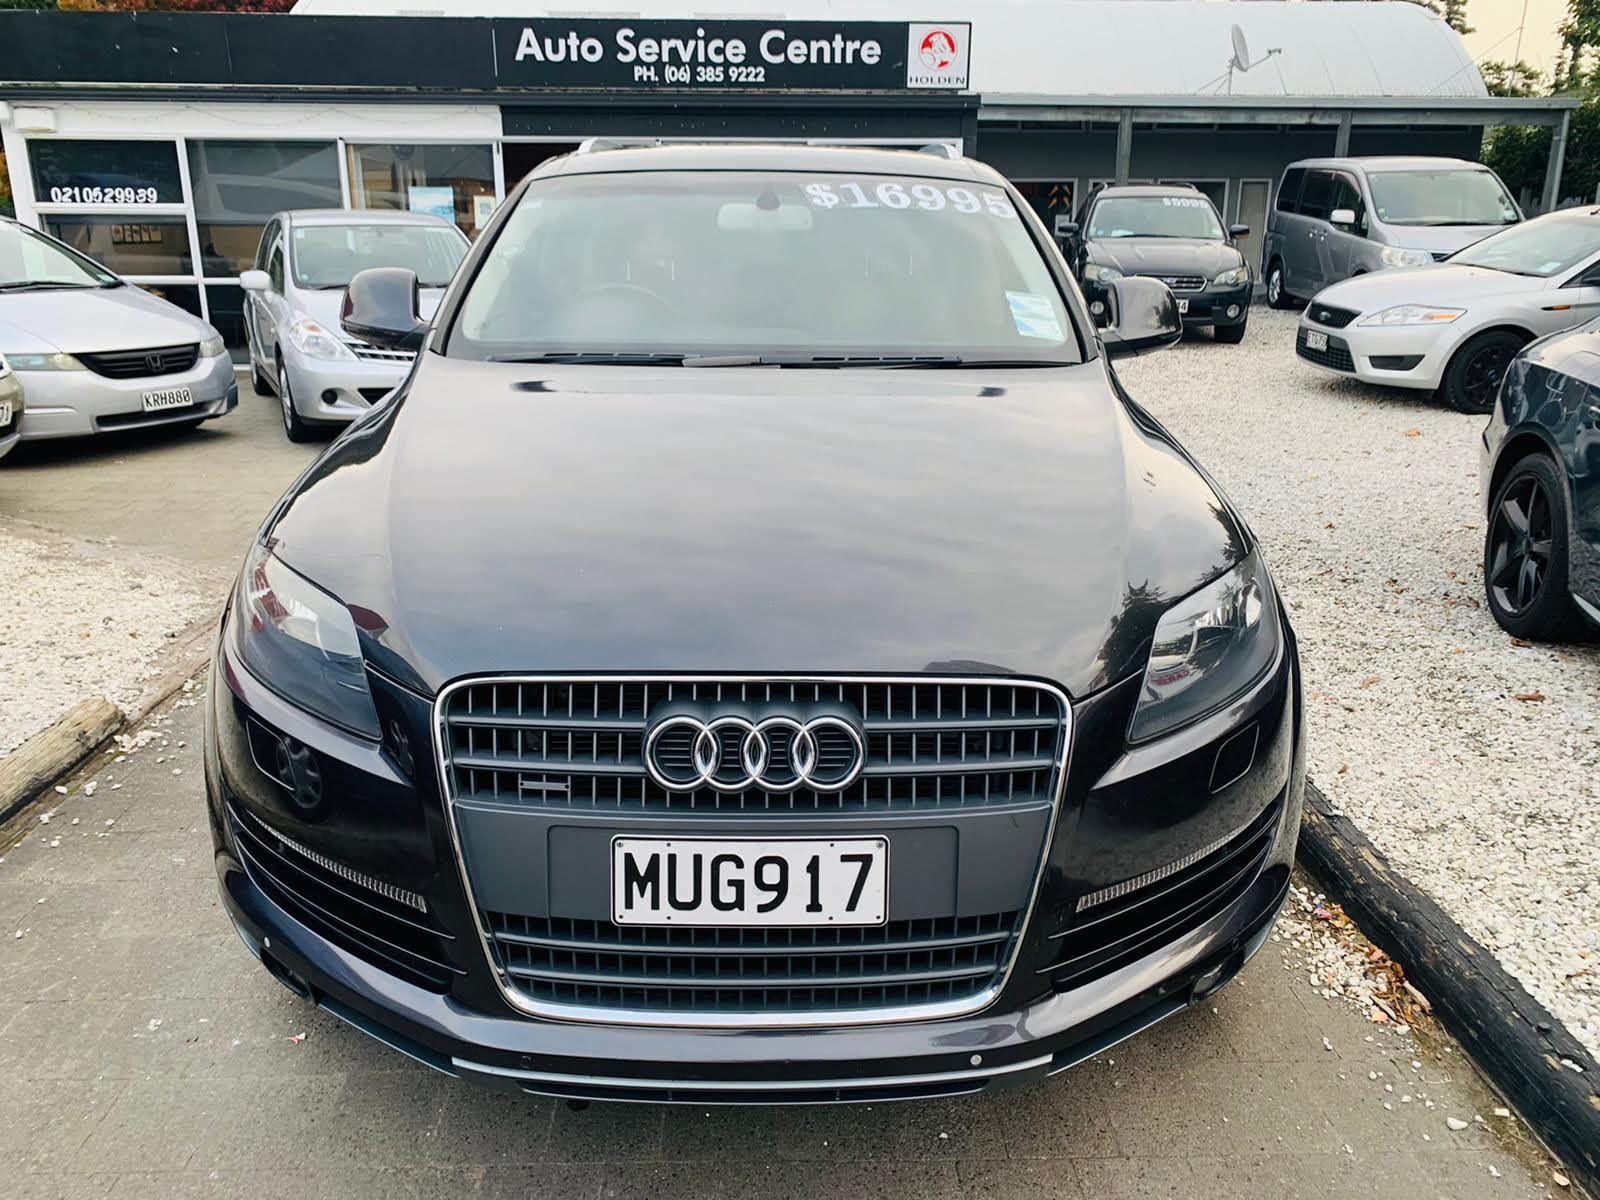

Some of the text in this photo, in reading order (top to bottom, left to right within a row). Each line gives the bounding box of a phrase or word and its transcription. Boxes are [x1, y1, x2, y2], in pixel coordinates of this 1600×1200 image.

[515, 27, 881, 64] Auto Service Centre
[633, 64, 765, 84] PH. (06) 385 9222
[909, 76, 966, 85] HOLDEN
[805, 182, 1017, 219] $16995
[624, 852, 873, 913] MUG917
